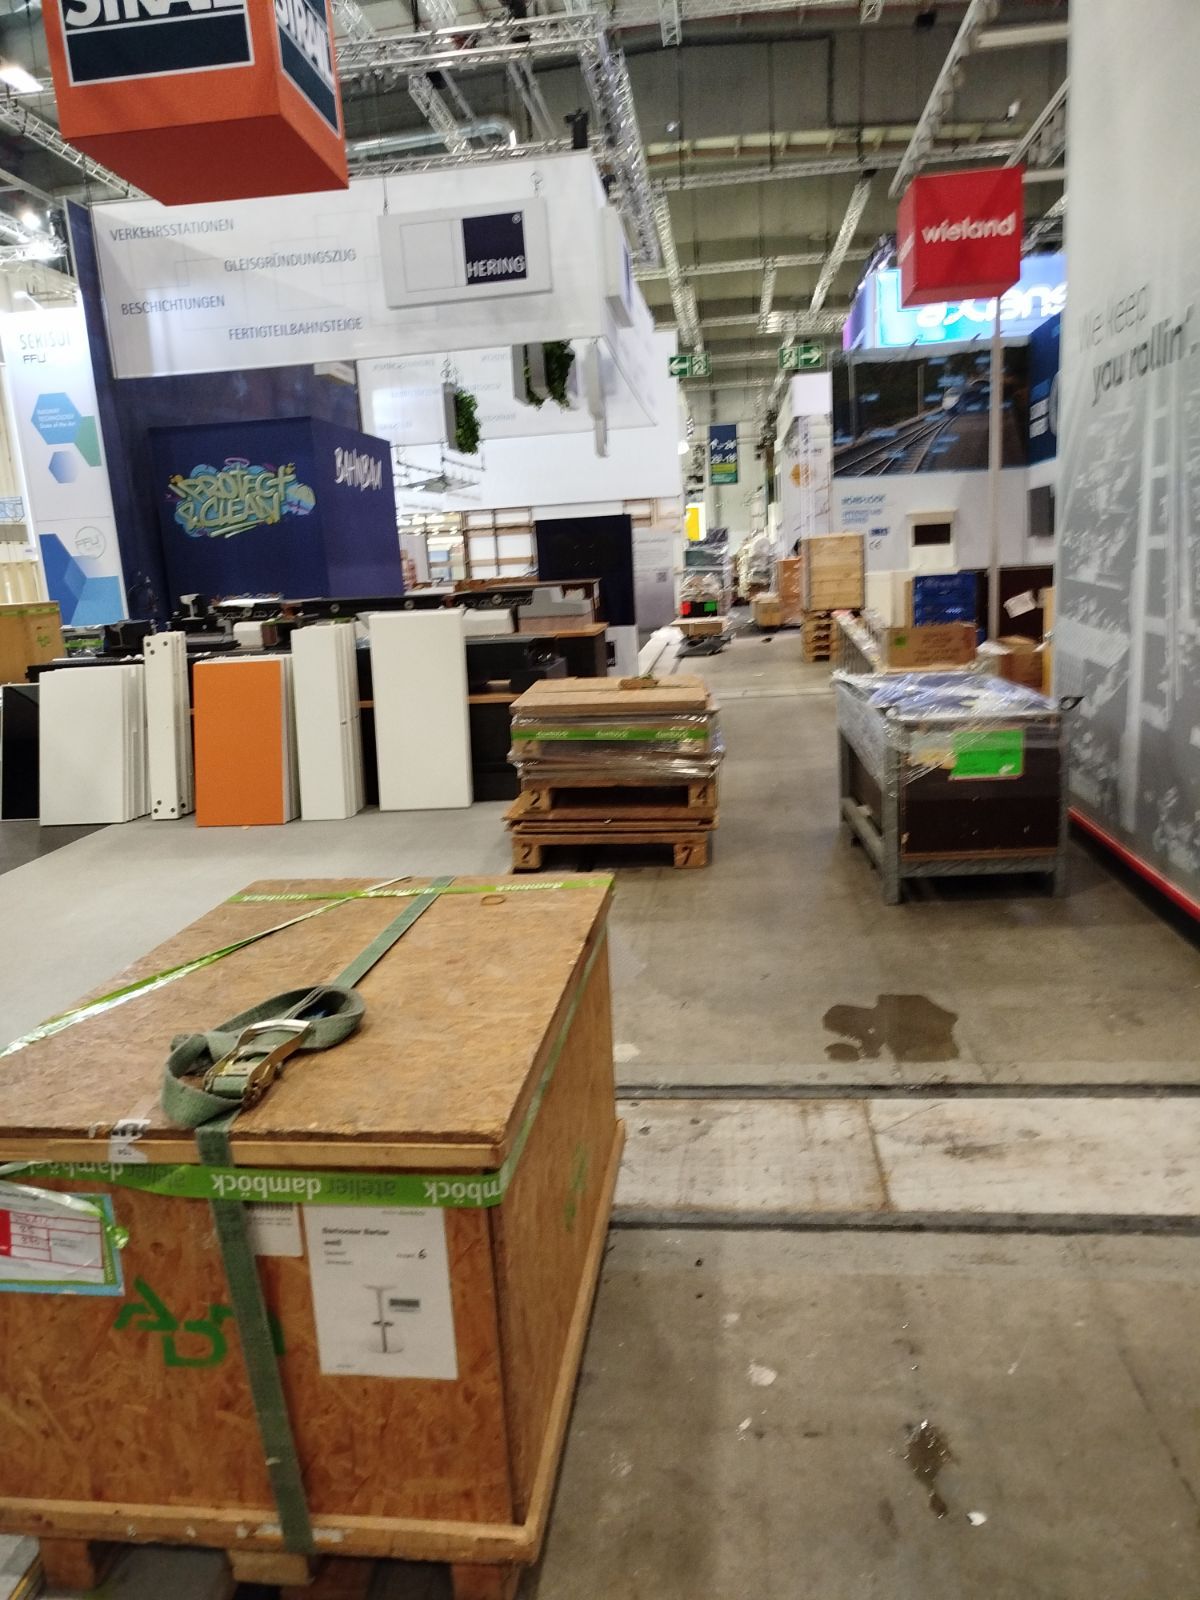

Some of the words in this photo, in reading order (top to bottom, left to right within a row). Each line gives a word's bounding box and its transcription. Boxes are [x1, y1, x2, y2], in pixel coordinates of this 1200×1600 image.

[110, 219, 234, 241] VERKEHRSSTATIONEN
[921, 210, 1016, 244] wieland
[466, 255, 526, 278] HERING
[121, 295, 225, 315] BESCHICHTUNGEN
[228, 317, 363, 340] FERTIGTEILBAHNSTEIGE
[20, 331, 72, 350] SEKISUI
[23, 353, 47, 364] FFU
[1091, 352, 1127, 407] you
[169, 465, 297, 501] PROTECT
[201, 492, 281, 528] CLEAN
[210, 1174, 321, 1200] damböck
